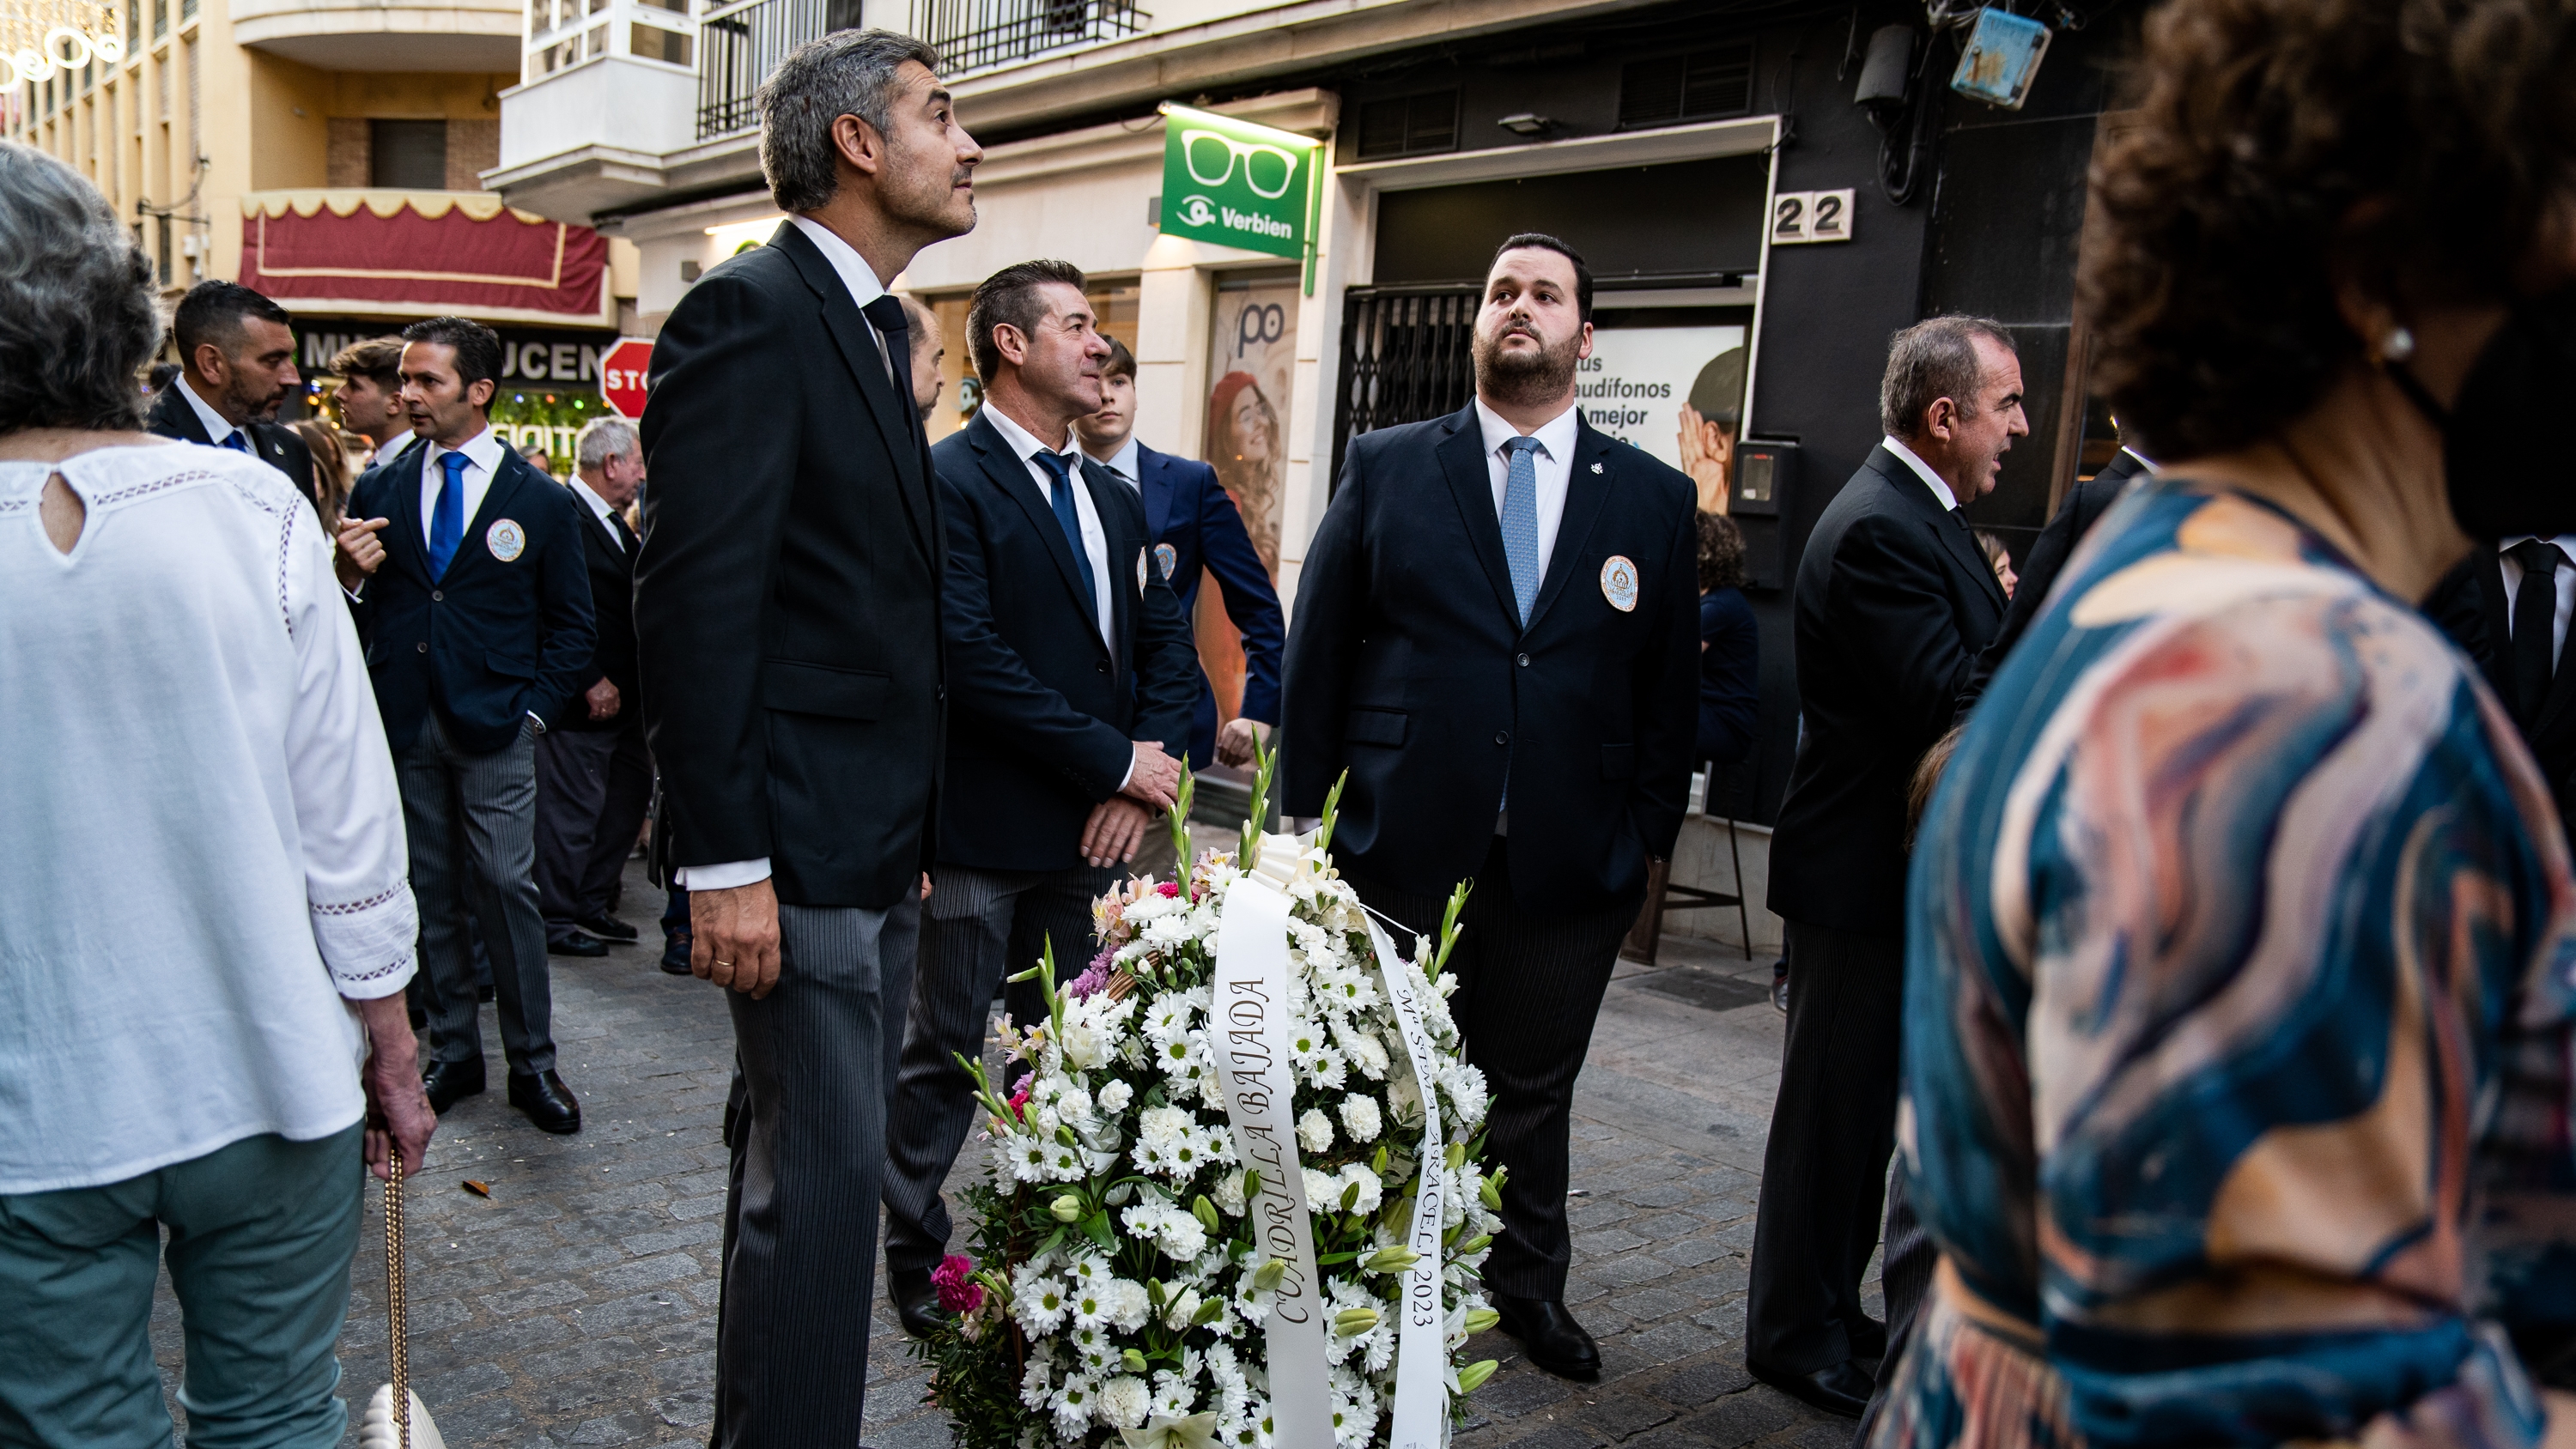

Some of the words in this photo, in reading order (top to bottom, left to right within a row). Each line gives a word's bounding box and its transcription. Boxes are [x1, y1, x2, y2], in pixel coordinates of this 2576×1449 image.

[1221, 206, 1292, 239] Verbien
[1776, 196, 1843, 233] 22
[1575, 378, 1671, 397] audífonos
[1589, 404, 1648, 428] mejor
[1229, 977, 1273, 1115] BAJADA
[1417, 1127, 1440, 1260] ARACELI
[1242, 1124, 1309, 1325] CUADRILLA
[1413, 1270, 1433, 1327] 2023
